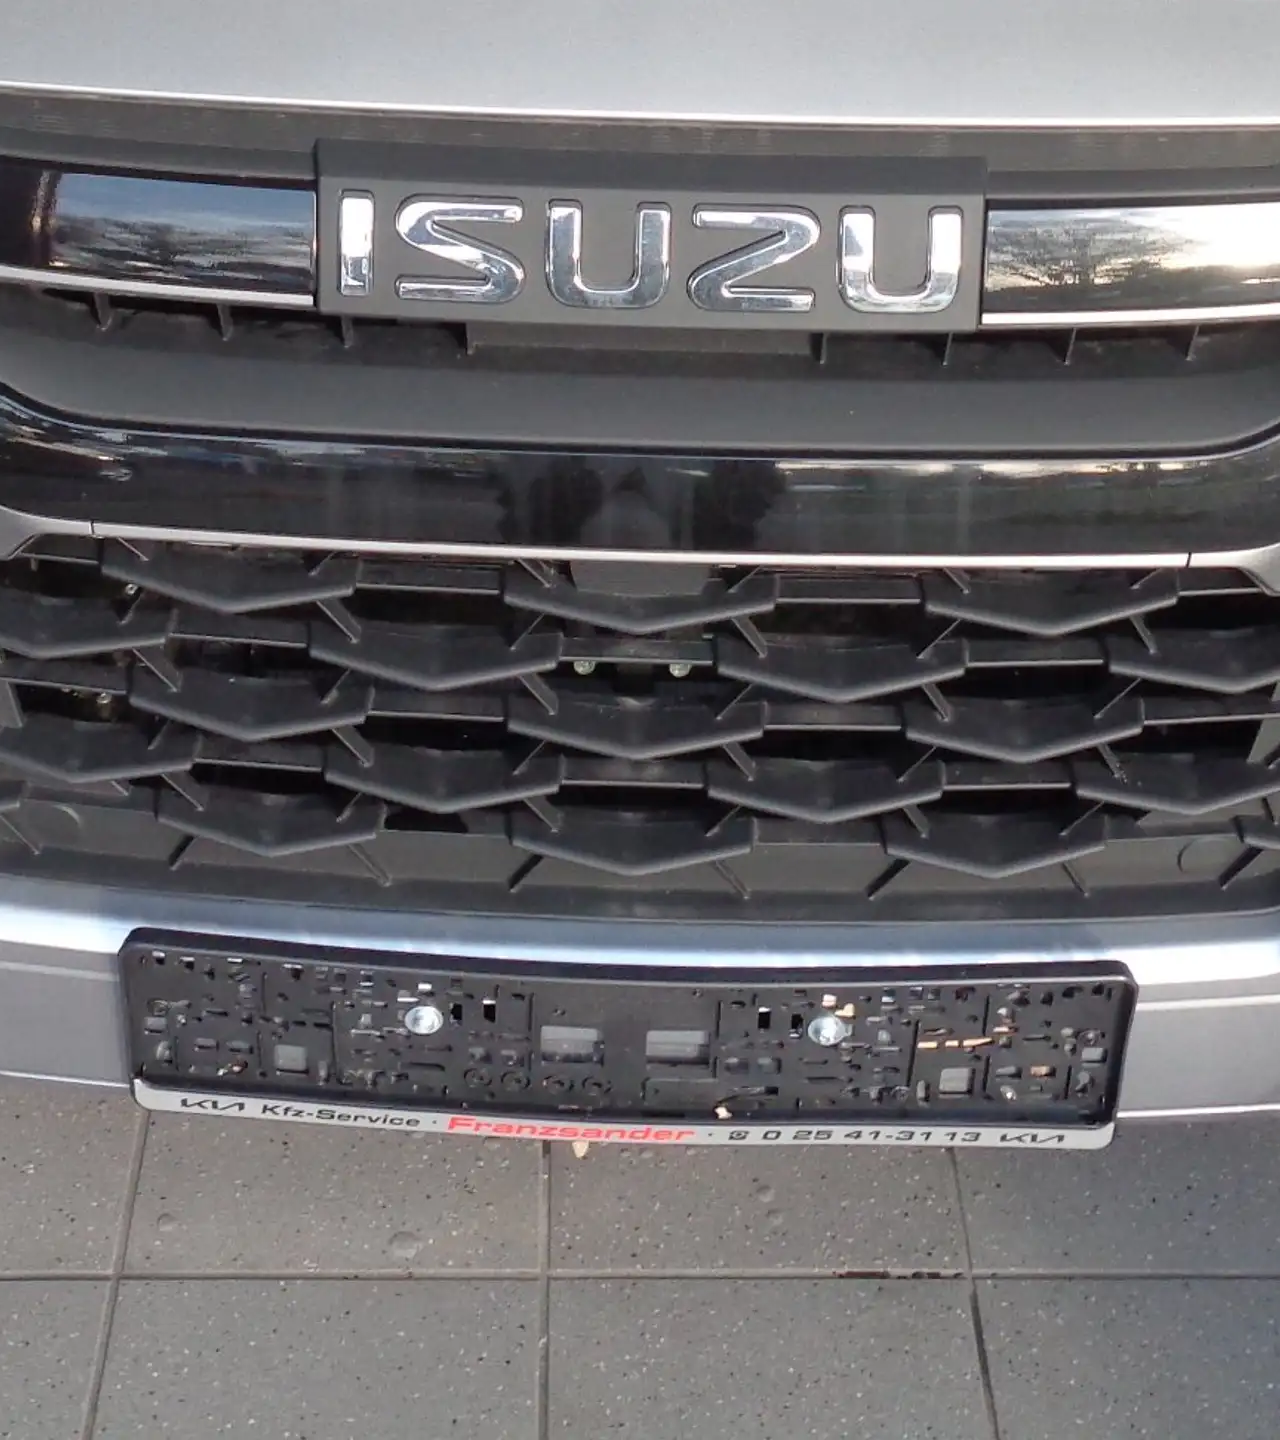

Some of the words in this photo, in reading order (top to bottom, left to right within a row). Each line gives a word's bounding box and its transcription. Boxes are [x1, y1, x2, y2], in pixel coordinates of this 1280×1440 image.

[337, 189, 963, 314] ISUZU
[261, 1103, 421, 1128] Kfz-Service
[447, 1115, 695, 1141] Franzsander
